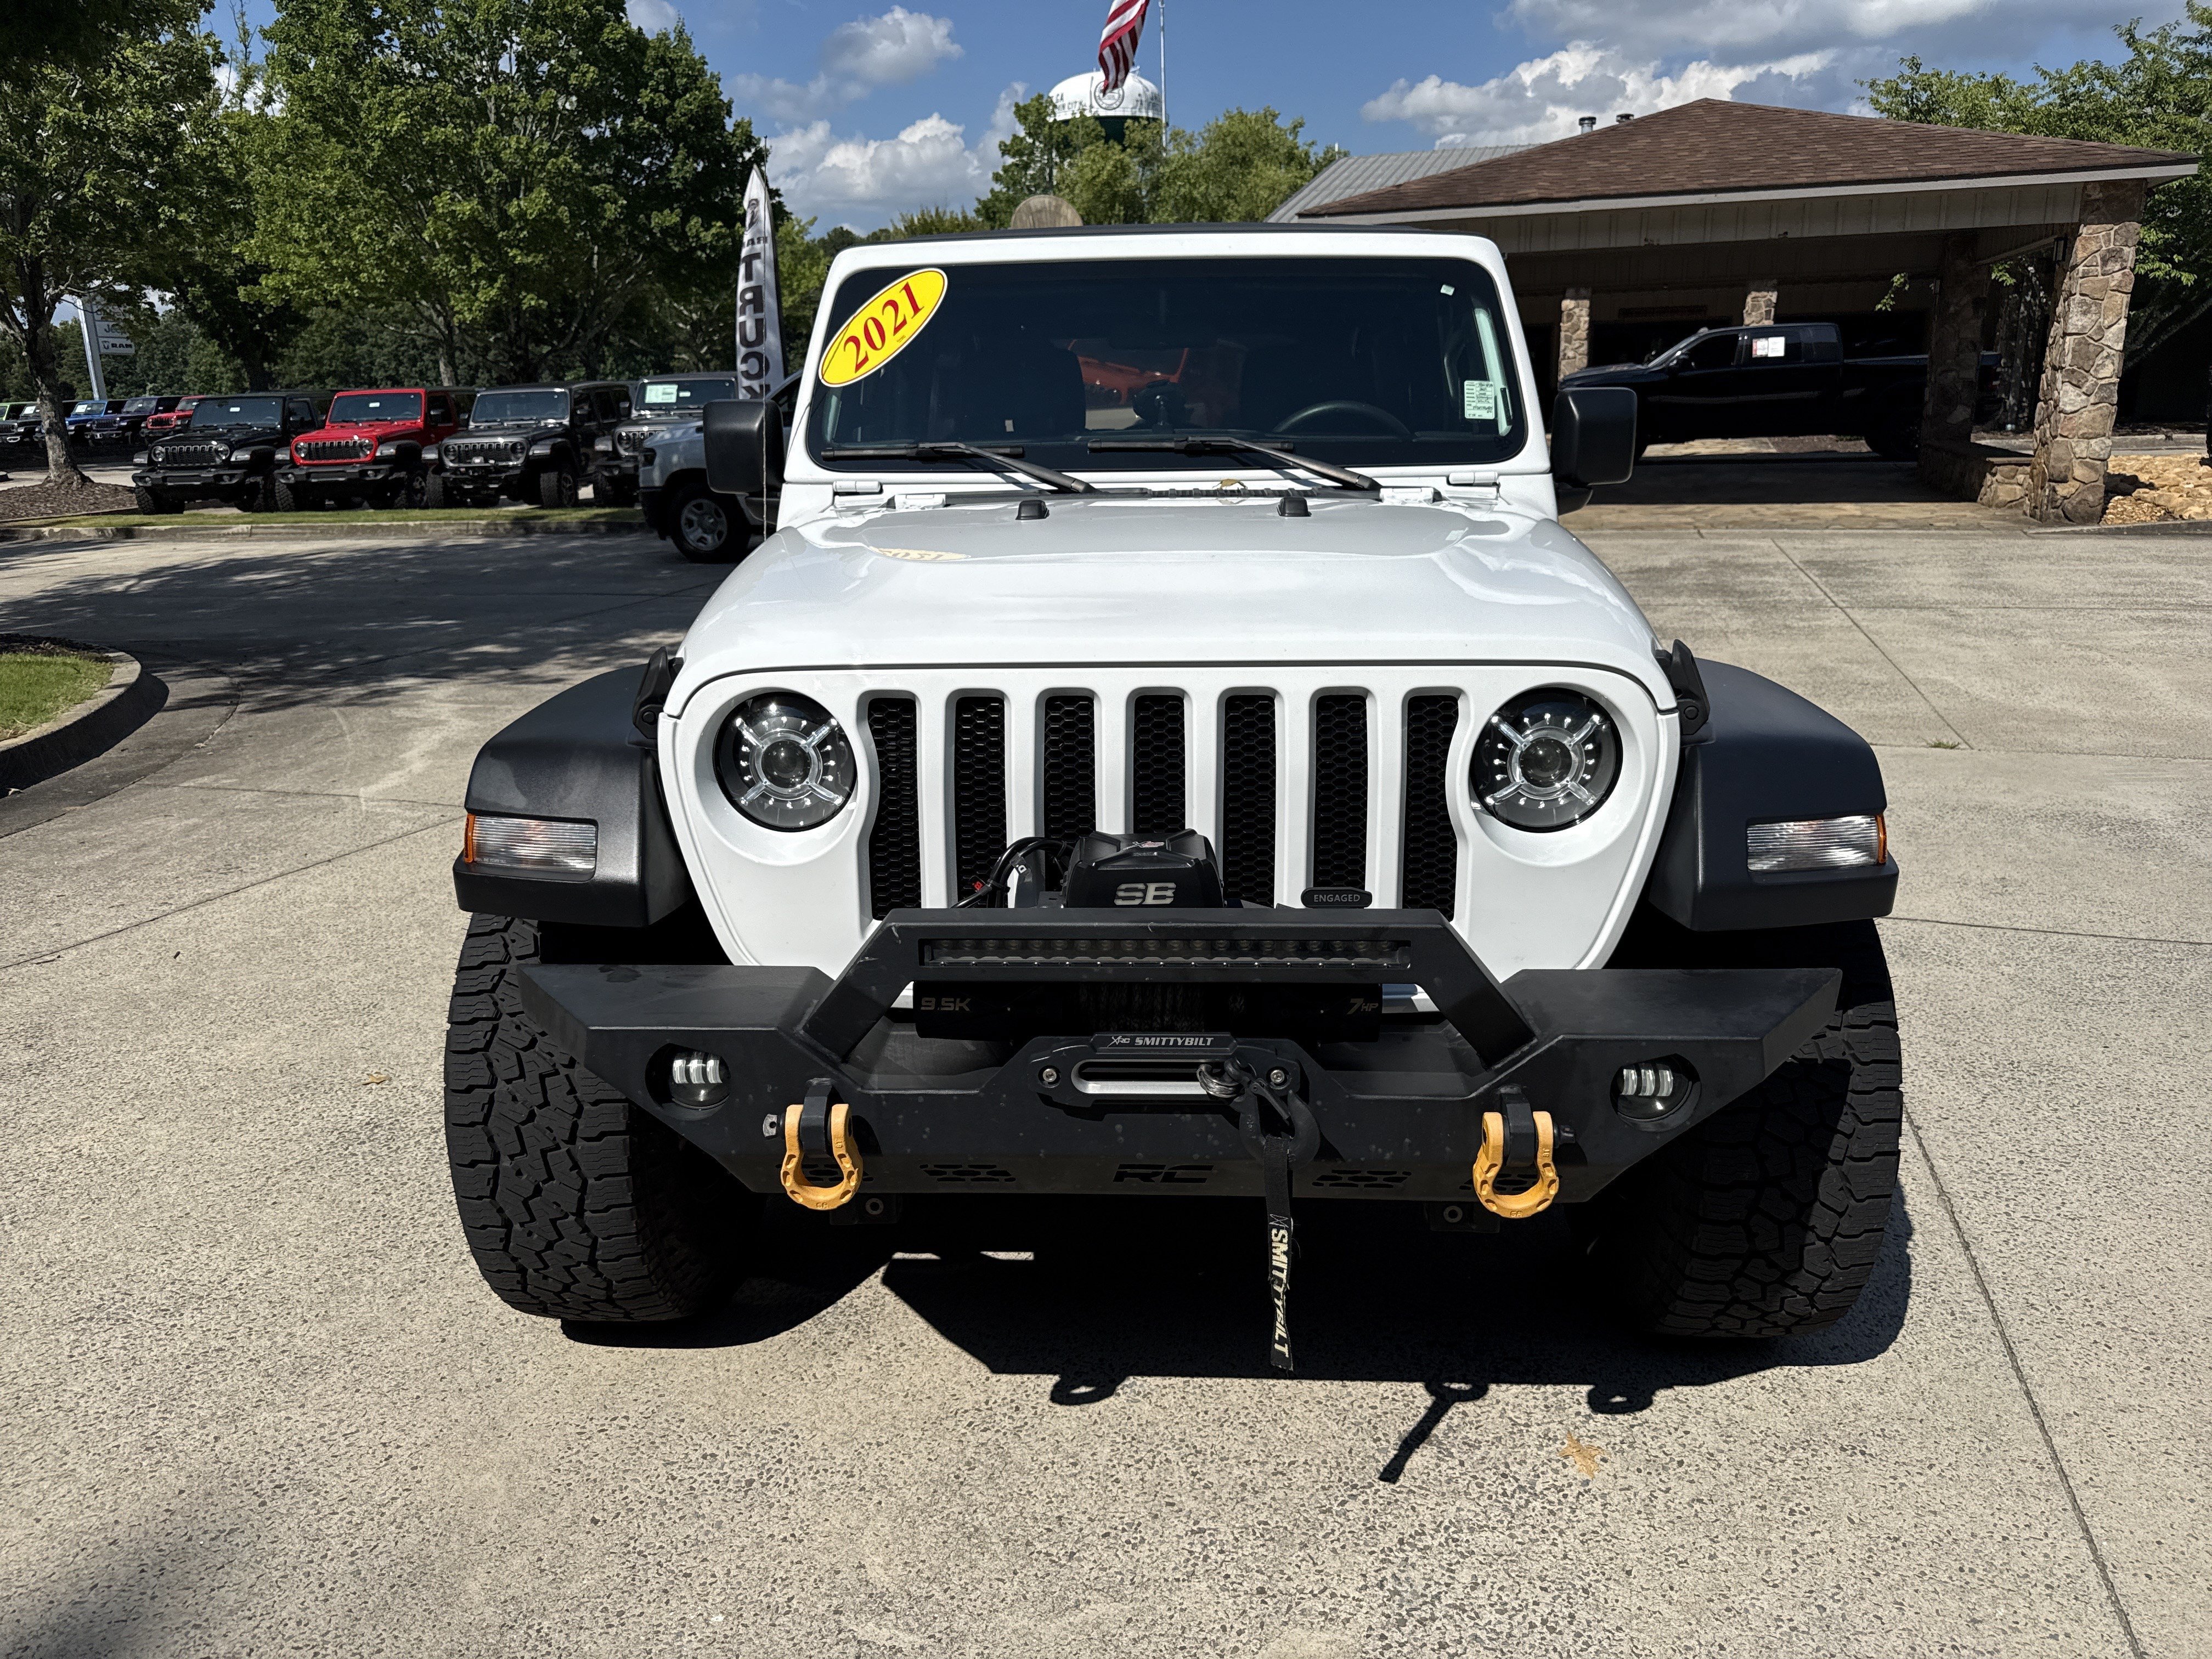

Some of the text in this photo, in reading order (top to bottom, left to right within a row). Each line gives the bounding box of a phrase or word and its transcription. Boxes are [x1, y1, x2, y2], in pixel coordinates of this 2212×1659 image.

[843, 281, 925, 374] 2021
[1313, 894, 1361, 902] ENGAGED
[921, 997, 971, 1011] 9.5K
[1135, 1037, 1214, 1046] SMITTYBILT
[1113, 1164, 1214, 1183] RC
